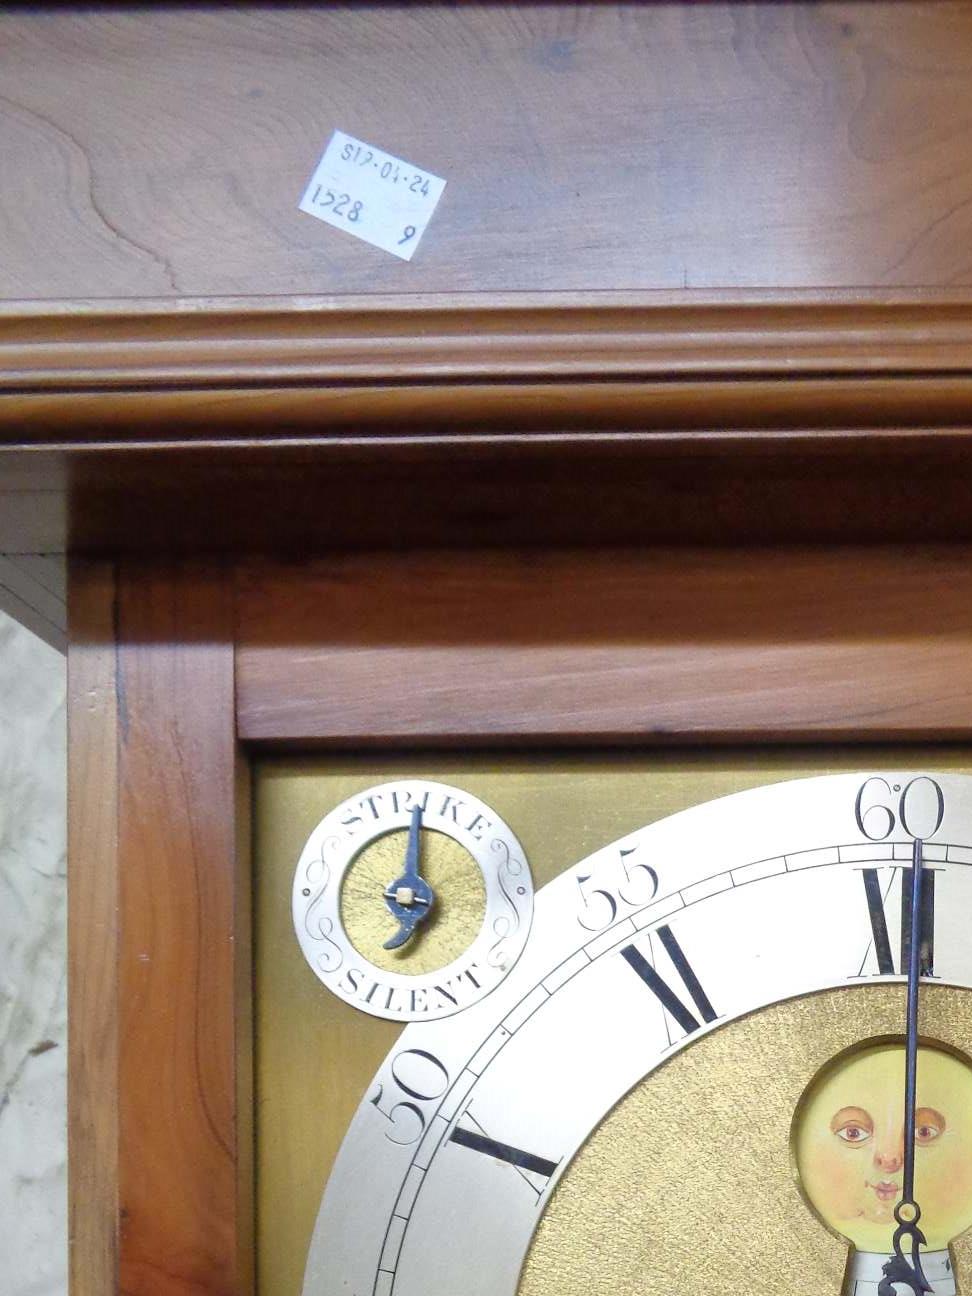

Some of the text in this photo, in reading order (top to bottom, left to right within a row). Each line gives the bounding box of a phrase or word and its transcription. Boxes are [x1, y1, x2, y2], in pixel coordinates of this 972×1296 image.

[397, 225, 416, 245] 9
[341, 791, 492, 842] STRIKE
[855, 776, 945, 841] 60
[575, 843, 659, 932] 55
[847, 866, 946, 978] XII
[338, 963, 482, 1012] SILENT
[608, 918, 727, 1052] XI
[369, 1047, 450, 1146] 50
[443, 1097, 565, 1208] X
